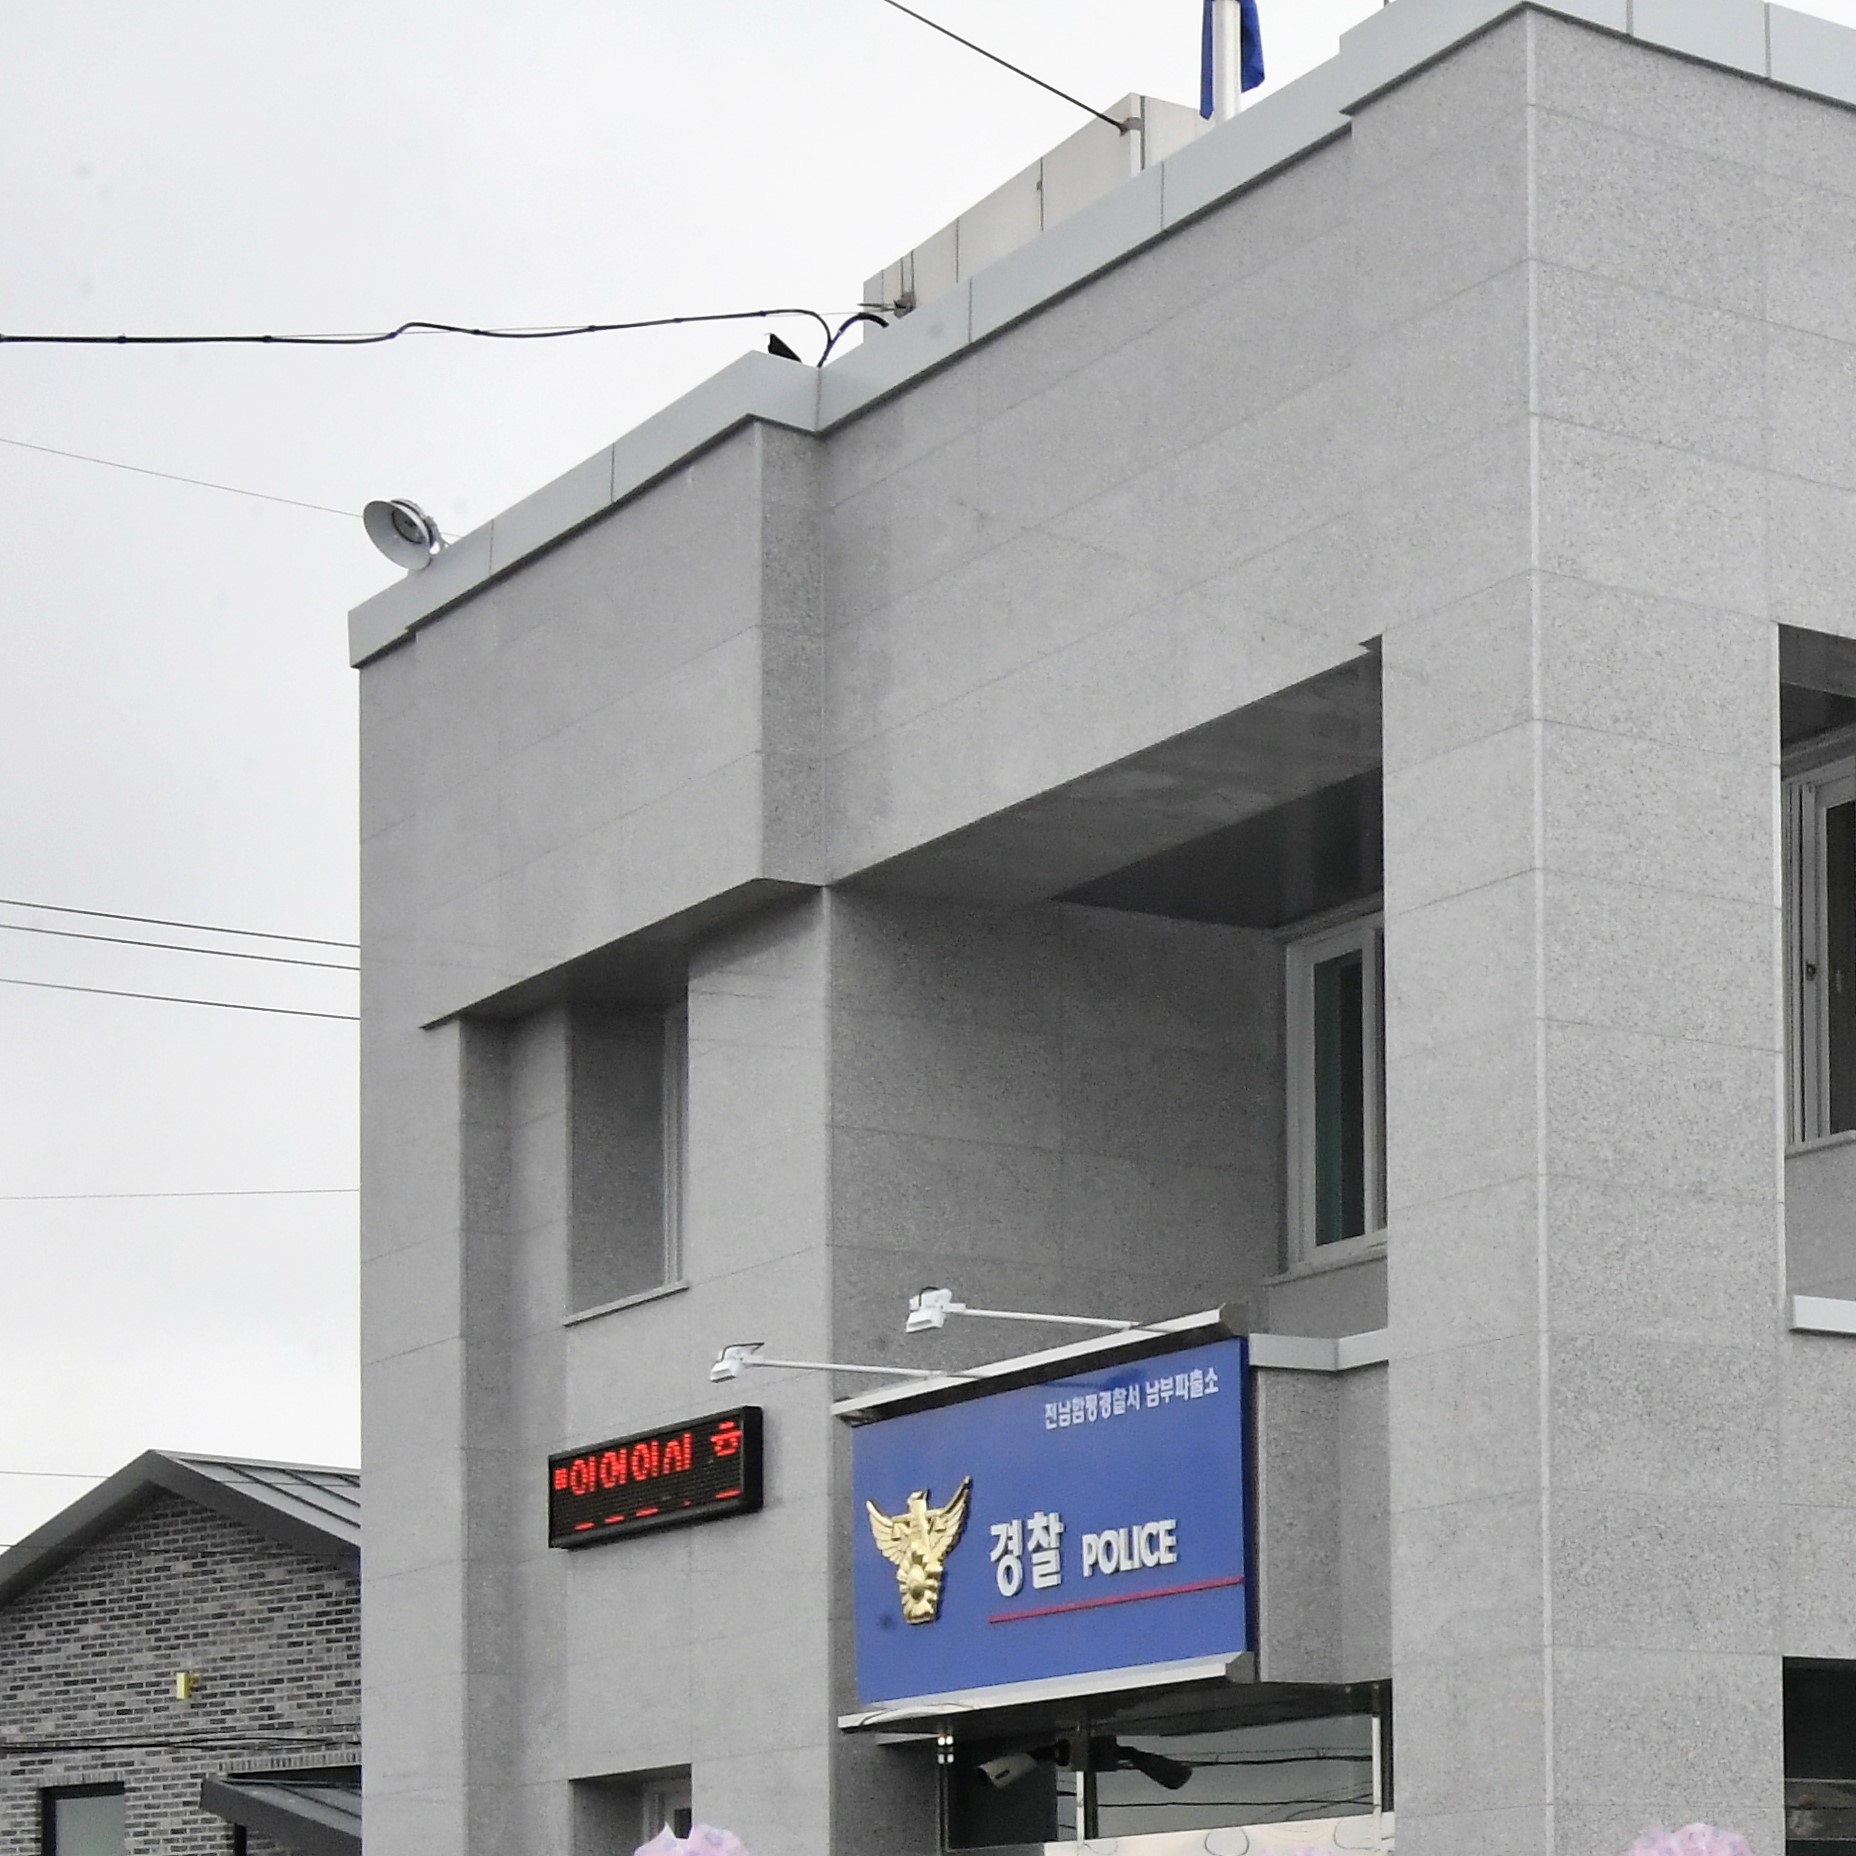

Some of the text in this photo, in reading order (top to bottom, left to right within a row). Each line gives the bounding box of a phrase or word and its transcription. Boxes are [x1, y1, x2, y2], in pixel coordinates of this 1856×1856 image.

[1045, 1367, 1220, 1430] 전남함평경찰서 남부파출소
[990, 1511, 1178, 1597] 경찰 POLICE
